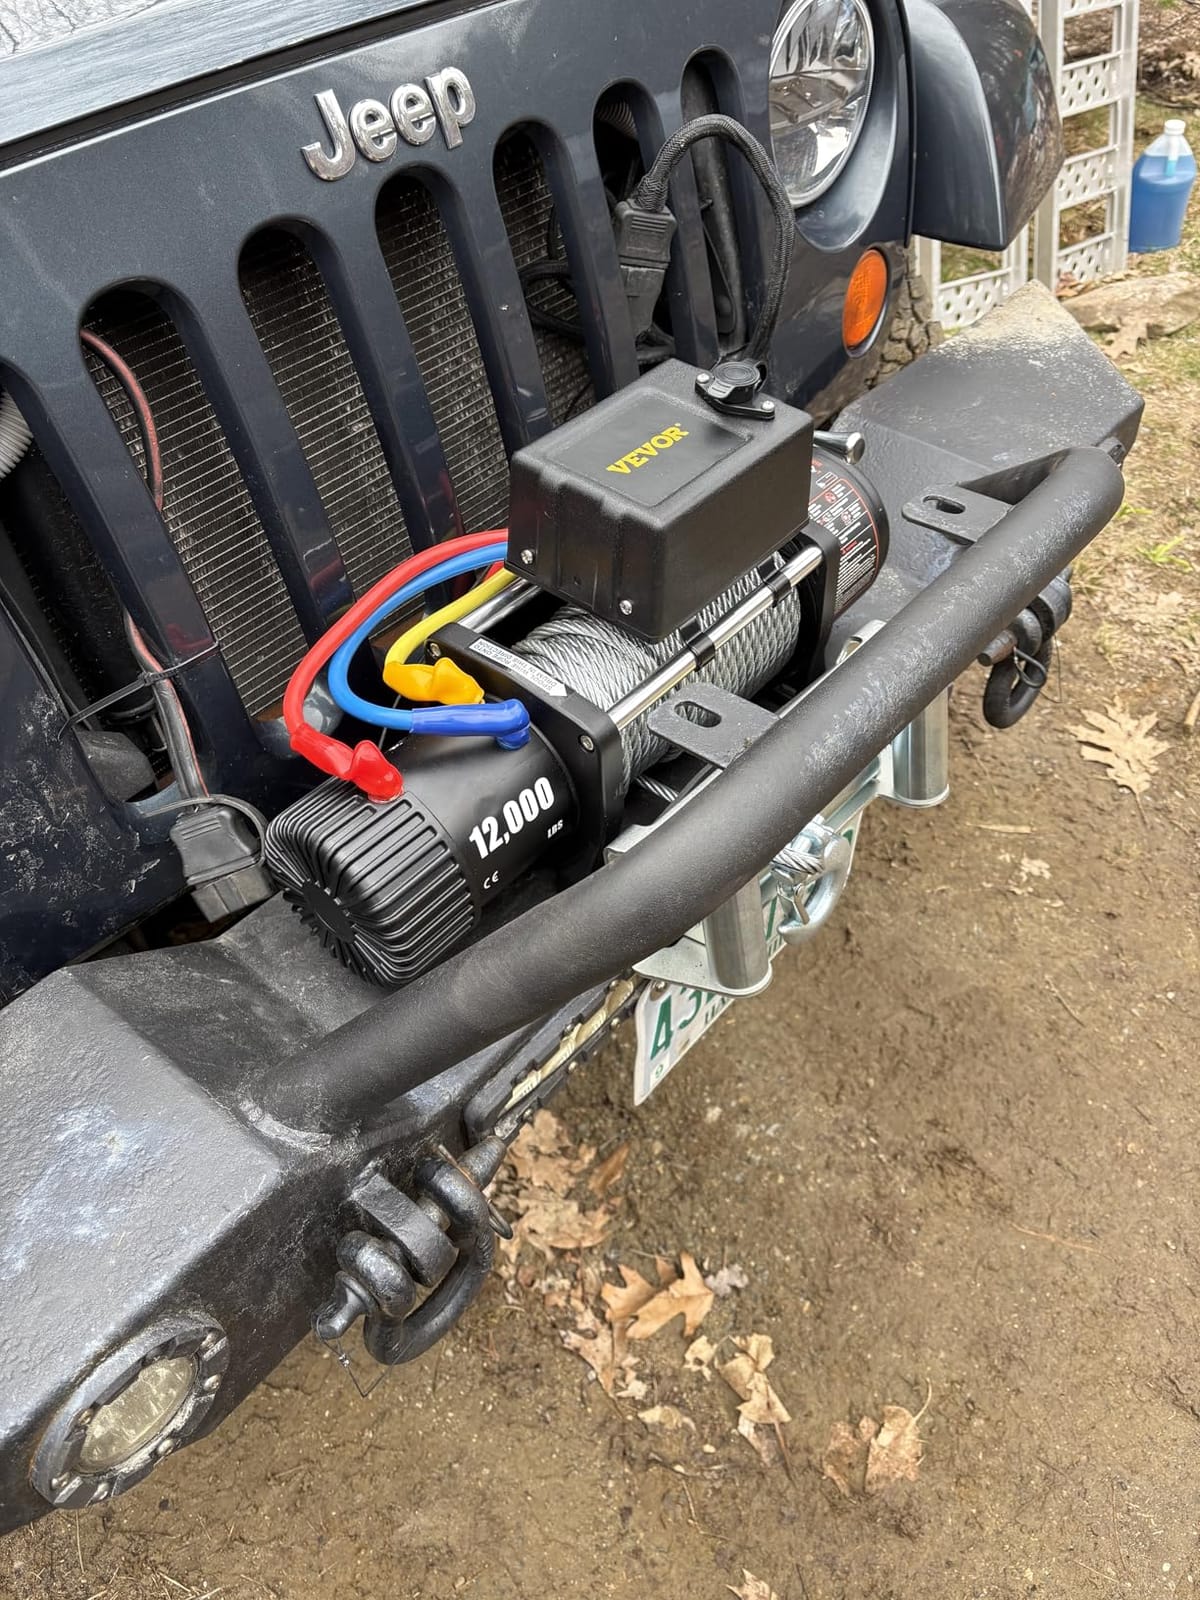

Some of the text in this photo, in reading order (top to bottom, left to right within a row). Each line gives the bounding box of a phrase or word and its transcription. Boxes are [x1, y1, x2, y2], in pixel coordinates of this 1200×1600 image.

[300, 66, 477, 182] Jeep
[606, 424, 690, 474] VEVOR
[473, 643, 493, 657] ONTO
[478, 640, 513, 660] DIRECTION
[512, 657, 528, 670] THIS
[535, 671, 558, 688] DRUM
[468, 776, 555, 859] 12,000
[547, 819, 564, 839] LBS
